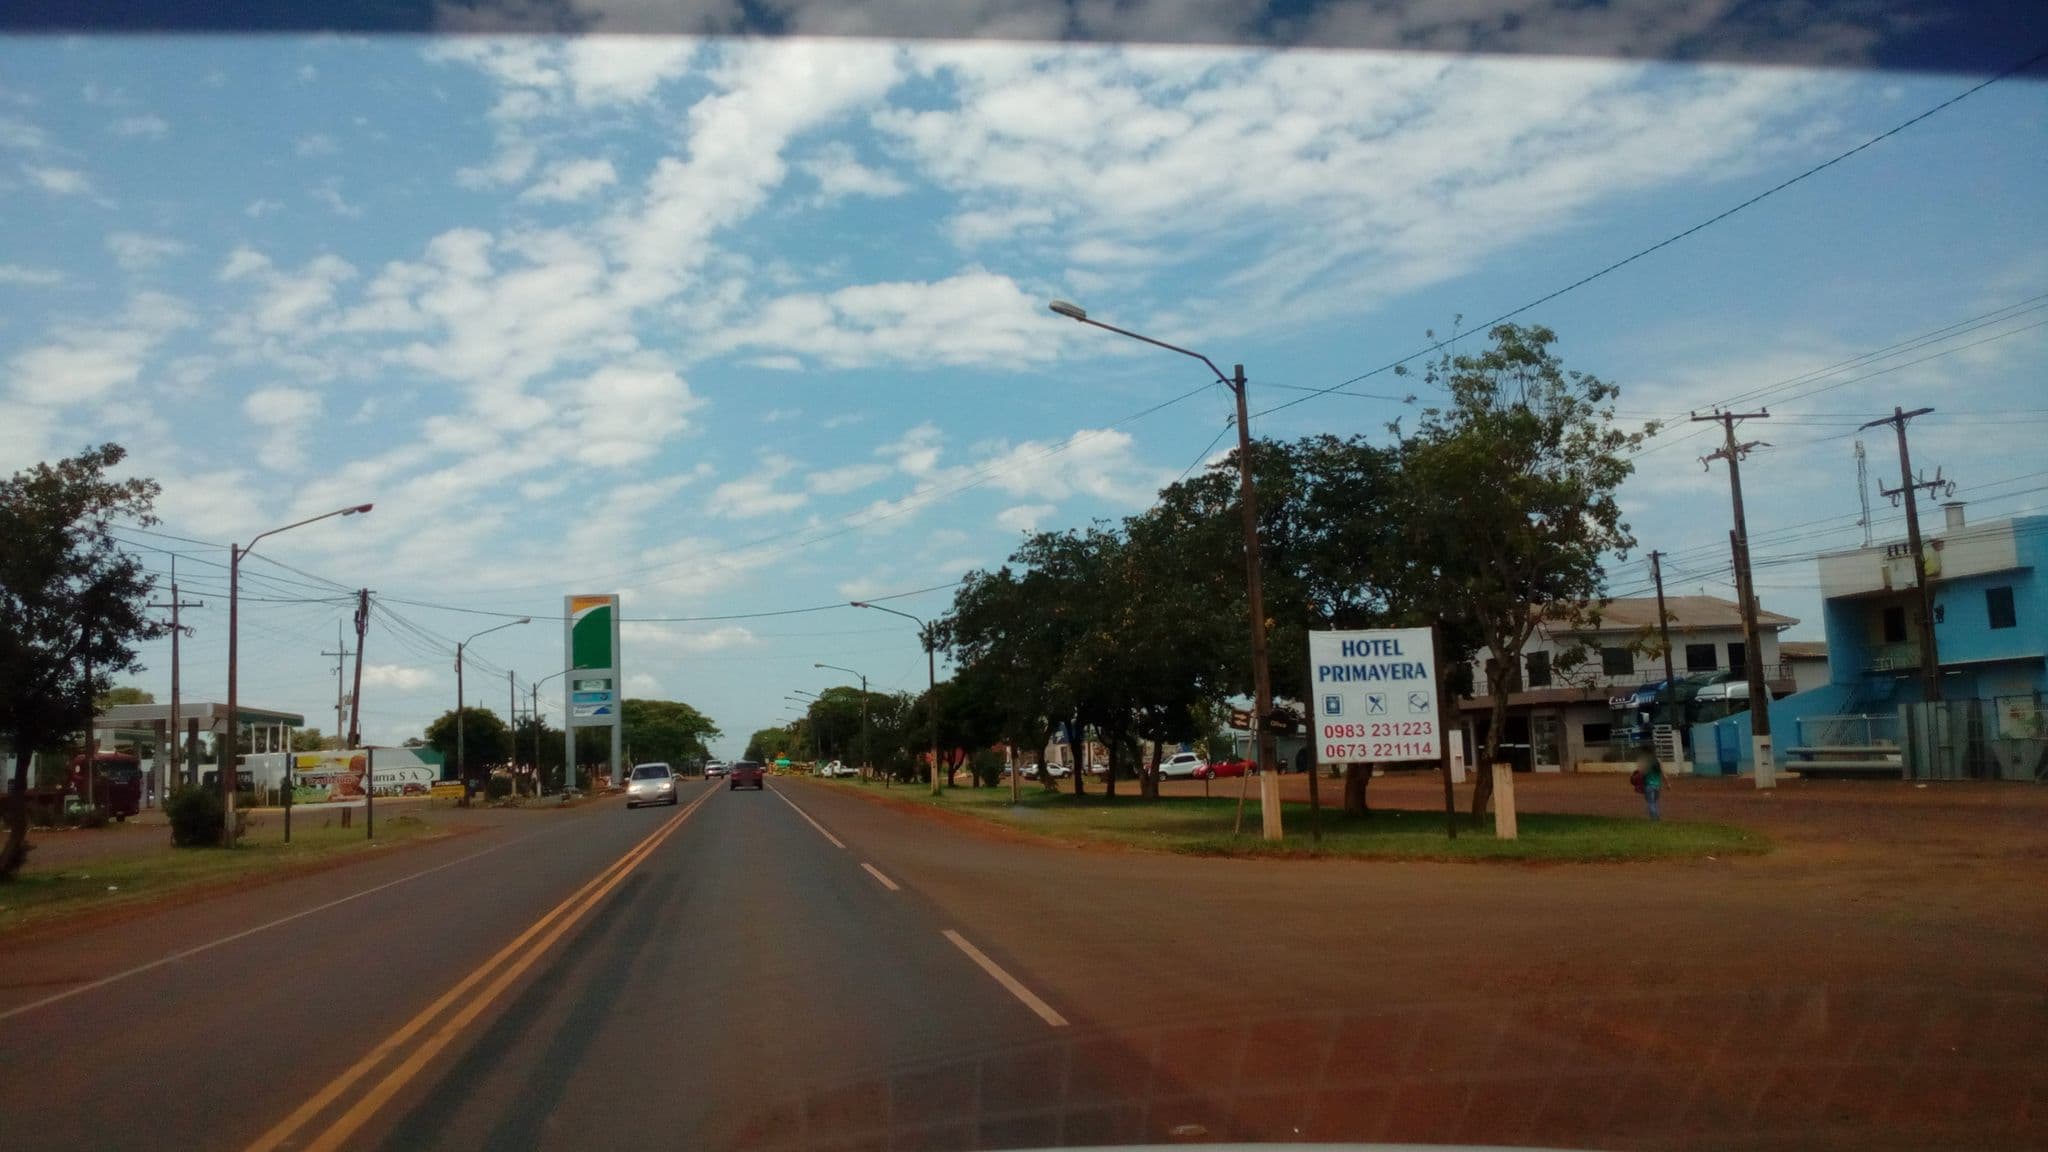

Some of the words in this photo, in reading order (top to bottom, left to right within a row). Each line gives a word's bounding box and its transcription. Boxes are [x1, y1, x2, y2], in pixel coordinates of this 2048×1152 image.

[1342, 639, 1403, 657] HOTEL
[1318, 662, 1428, 682] PRIMAVERA
[1324, 724, 1365, 739] 0983
[1371, 721, 1432, 737] 231223
[1325, 743, 1367, 758] 0673
[1373, 741, 1432, 757] 221114
